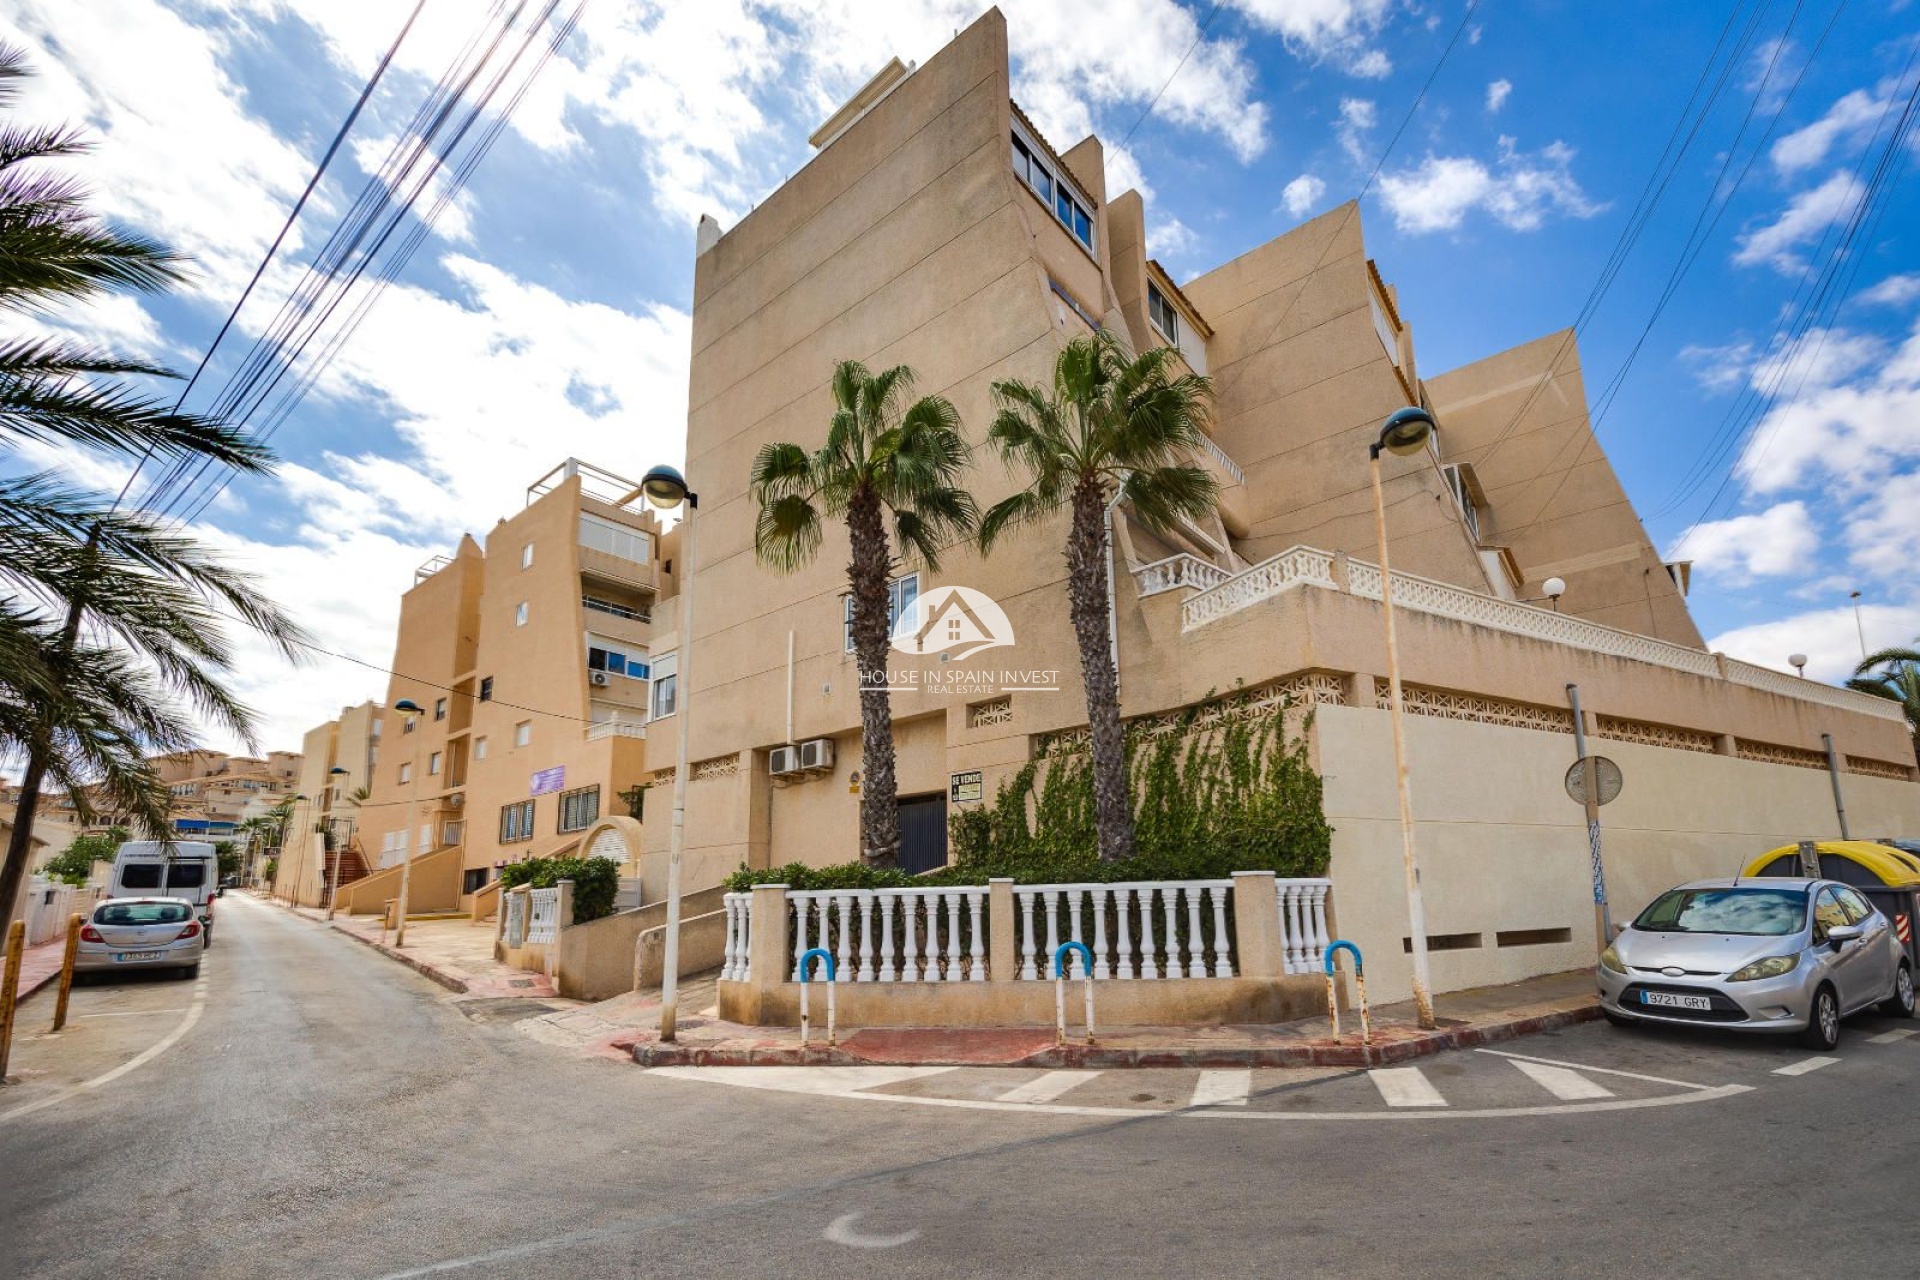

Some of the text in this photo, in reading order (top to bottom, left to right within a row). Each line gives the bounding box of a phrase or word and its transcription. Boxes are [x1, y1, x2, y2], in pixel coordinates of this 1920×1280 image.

[952, 773, 982, 786] SE VENDE
[1649, 994, 1707, 1008] 9721 GRY
